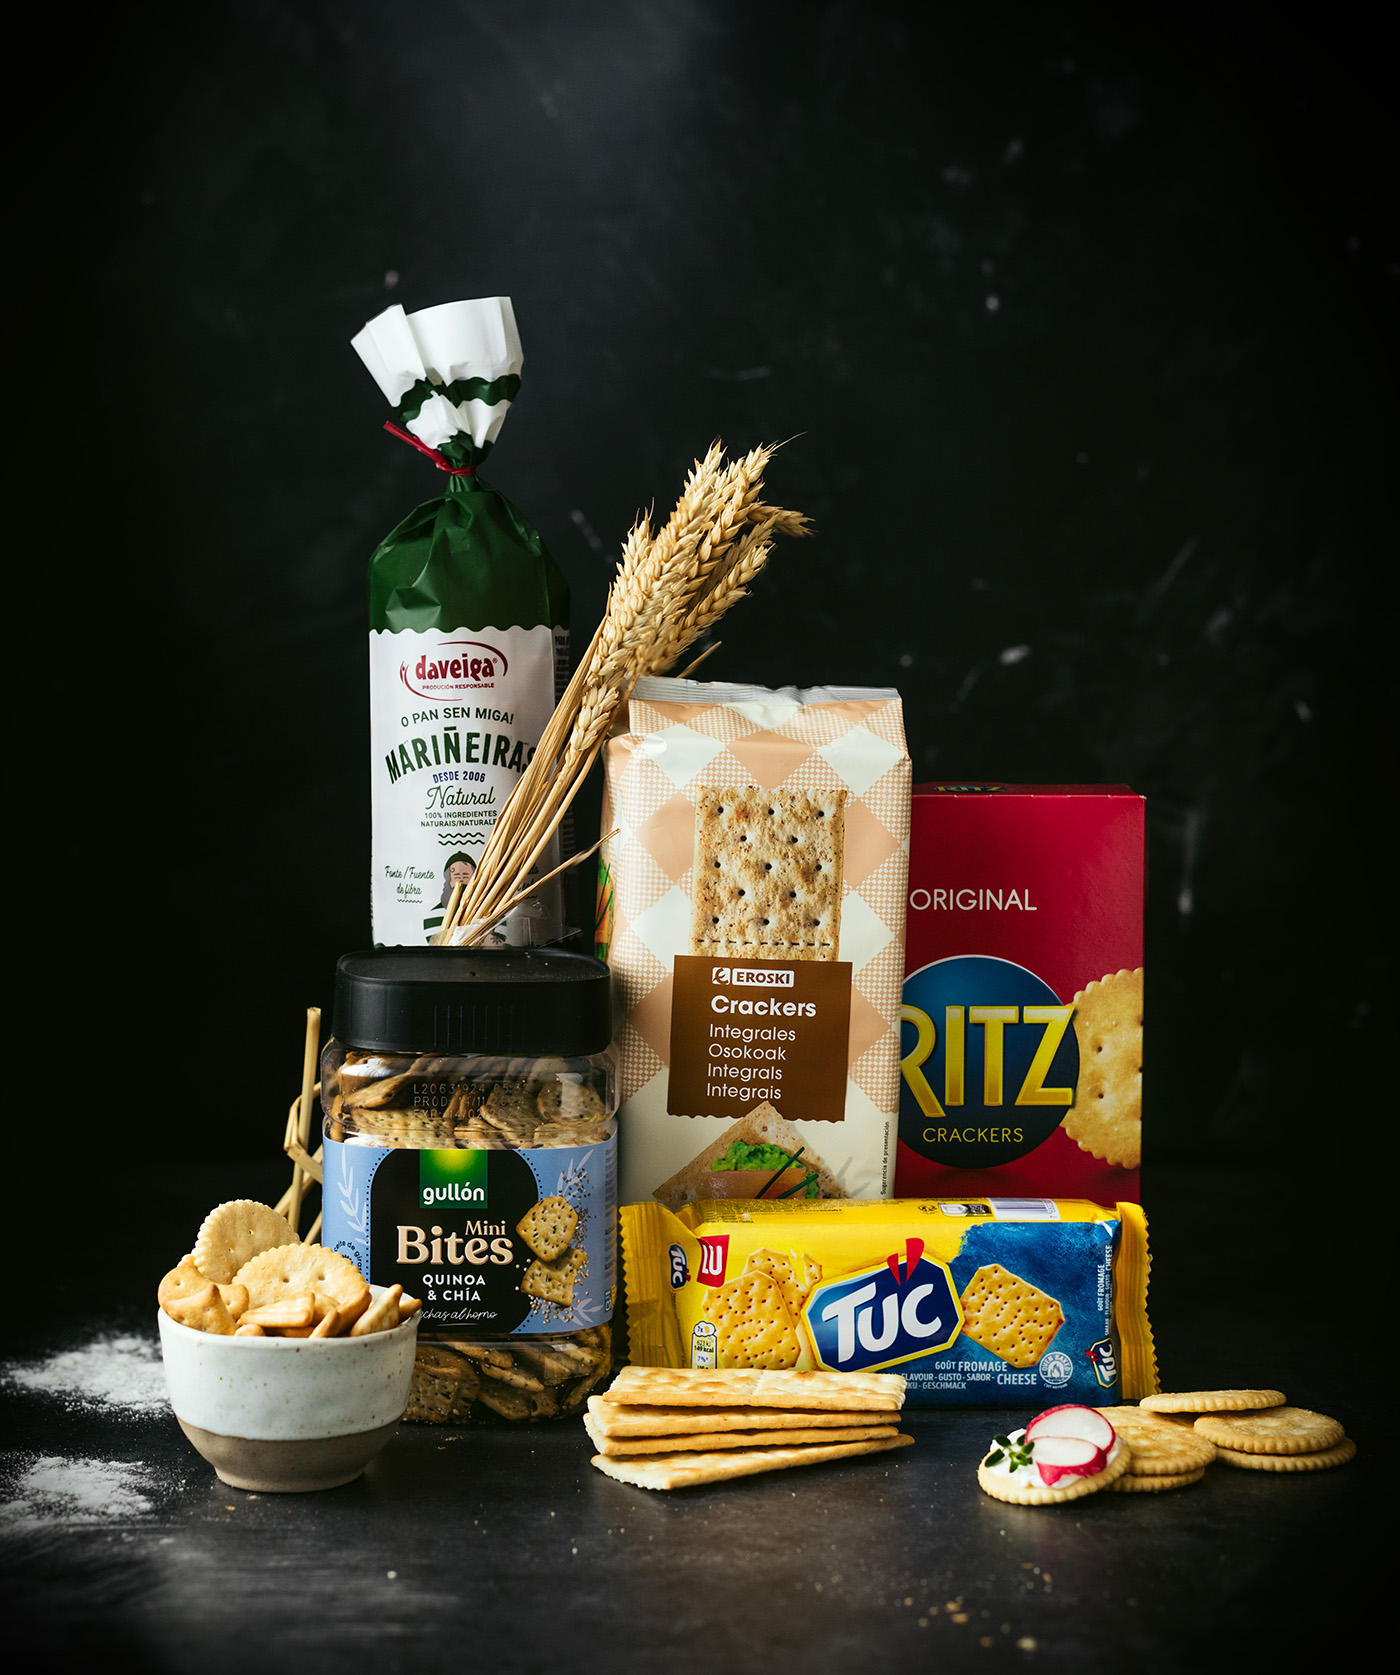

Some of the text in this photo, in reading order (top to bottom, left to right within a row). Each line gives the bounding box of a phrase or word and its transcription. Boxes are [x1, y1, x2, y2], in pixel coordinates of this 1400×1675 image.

[401, 707, 514, 727] O PAN SEN MIGA!
[432, 770, 486, 783] DESDE 2006
[425, 785, 496, 810] Natural
[420, 818, 497, 827] NATURAIS/NATURALE
[444, 810, 497, 818] INGREDIENTES
[397, 883, 404, 894] de
[909, 888, 1037, 911] ORIGINAL
[736, 971, 790, 984] EROSKI
[710, 994, 817, 1017] Crackers
[709, 1023, 796, 1043] Integrales
[708, 1043, 786, 1061] Osokoak
[899, 1004, 1077, 1118] RITZ
[707, 1063, 783, 1082] Integrals
[706, 1082, 782, 1101] Integrais
[922, 1127, 1024, 1143] CRACKERS
[880, 1164, 888, 1195] Sugerencia
[422, 1182, 485, 1205] gullón
[464, 1220, 507, 1236] Mini
[395, 1225, 514, 1266] Bites
[670, 1247, 686, 1284] TUC
[702, 1244, 722, 1275] LU
[422, 1274, 486, 1288] QUINOA
[1097, 1264, 1105, 1296] FROMAGE
[427, 1287, 481, 1301] & CHÍA
[450, 1307, 467, 1320] al
[465, 1308, 498, 1320] horno
[822, 1282, 942, 1363] TUC
[935, 1360, 1007, 1372] GOÛT FROMAGE
[1098, 1344, 1116, 1382] TUC
[922, 1382, 967, 1390] GESCHMACK
[938, 1373, 961, 1382] GUSTO
[996, 1373, 1037, 1385] CHEESE
